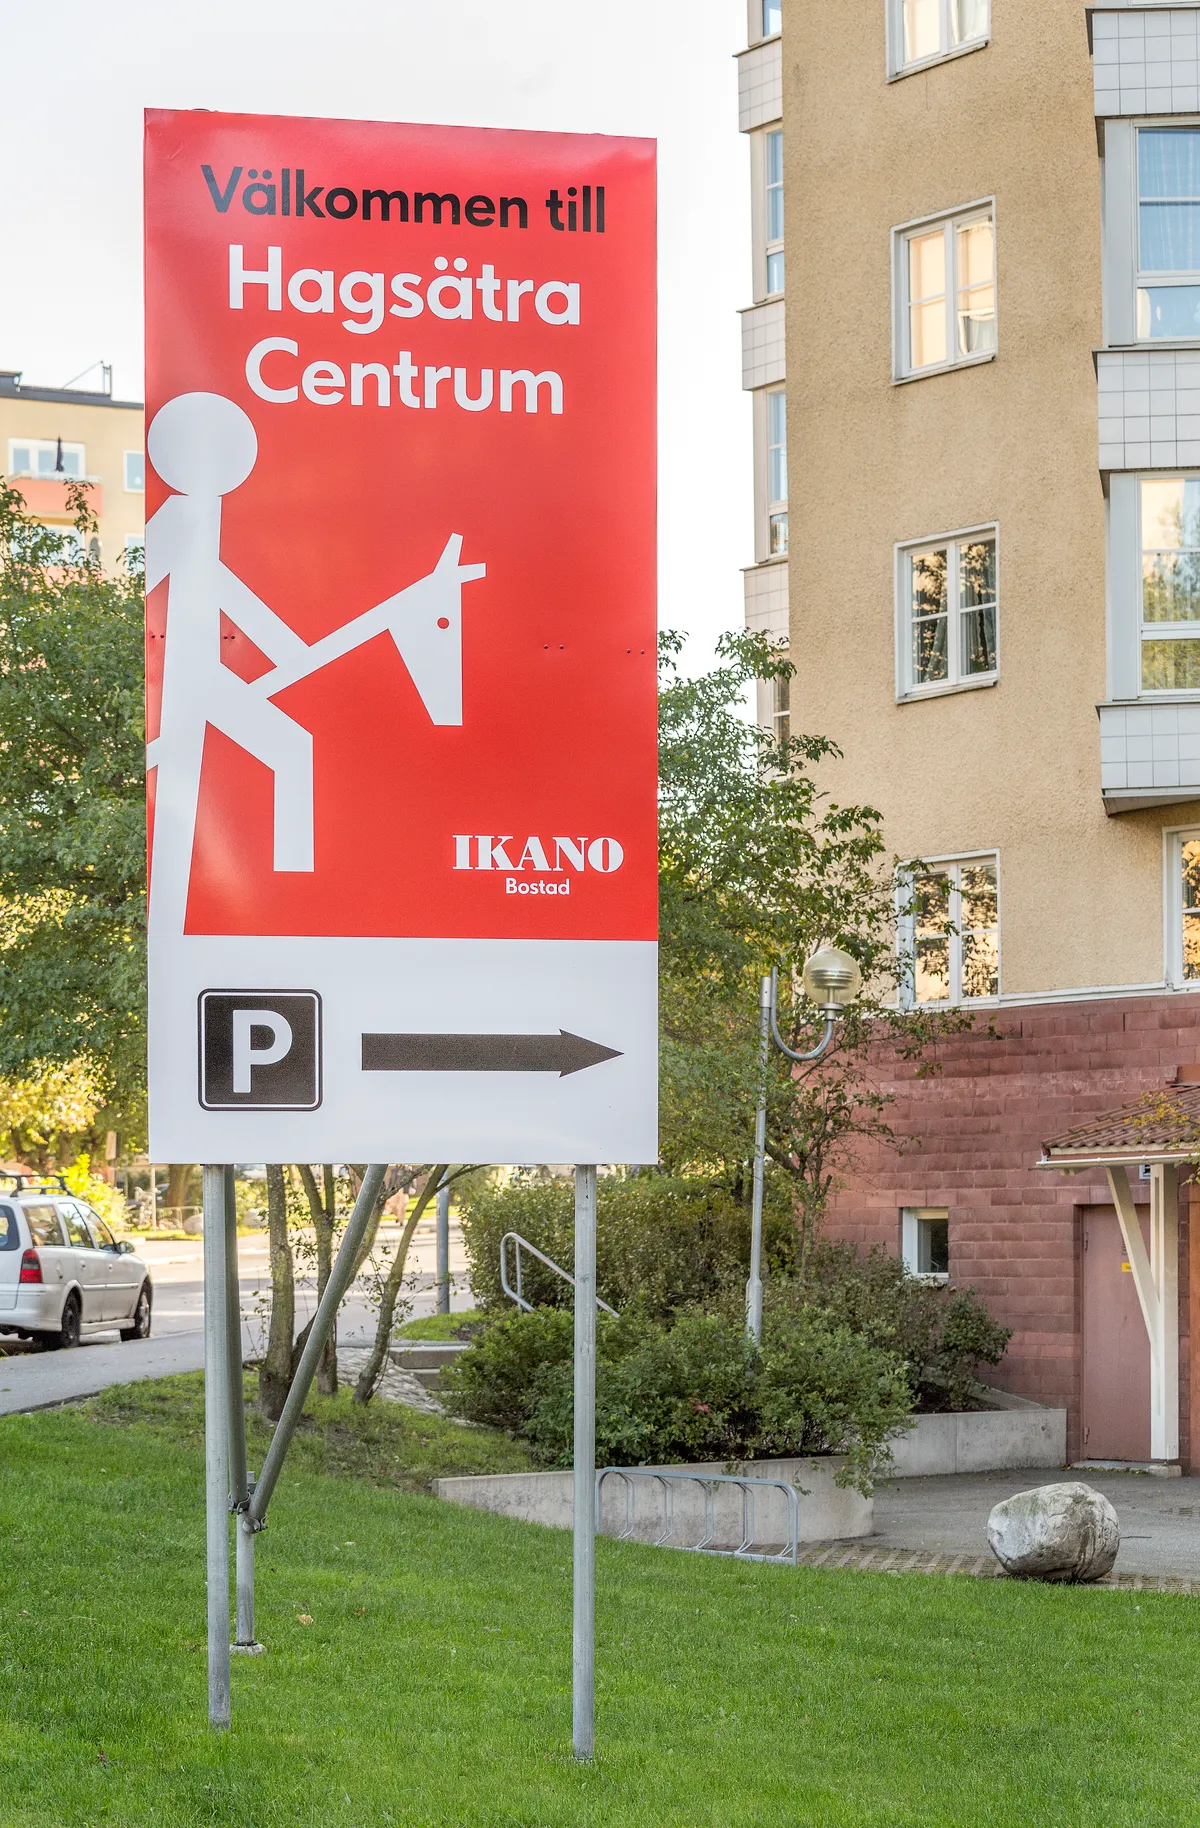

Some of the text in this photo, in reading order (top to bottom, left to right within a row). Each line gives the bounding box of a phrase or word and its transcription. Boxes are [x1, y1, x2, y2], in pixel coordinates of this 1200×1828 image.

[200, 164, 605, 233] Välkommen till
[228, 243, 581, 335] Hagsätra
[245, 336, 564, 415] Centrum
[452, 834, 625, 873] IKANO
[505, 877, 571, 896] Bostad
[232, 1009, 293, 1094] P
